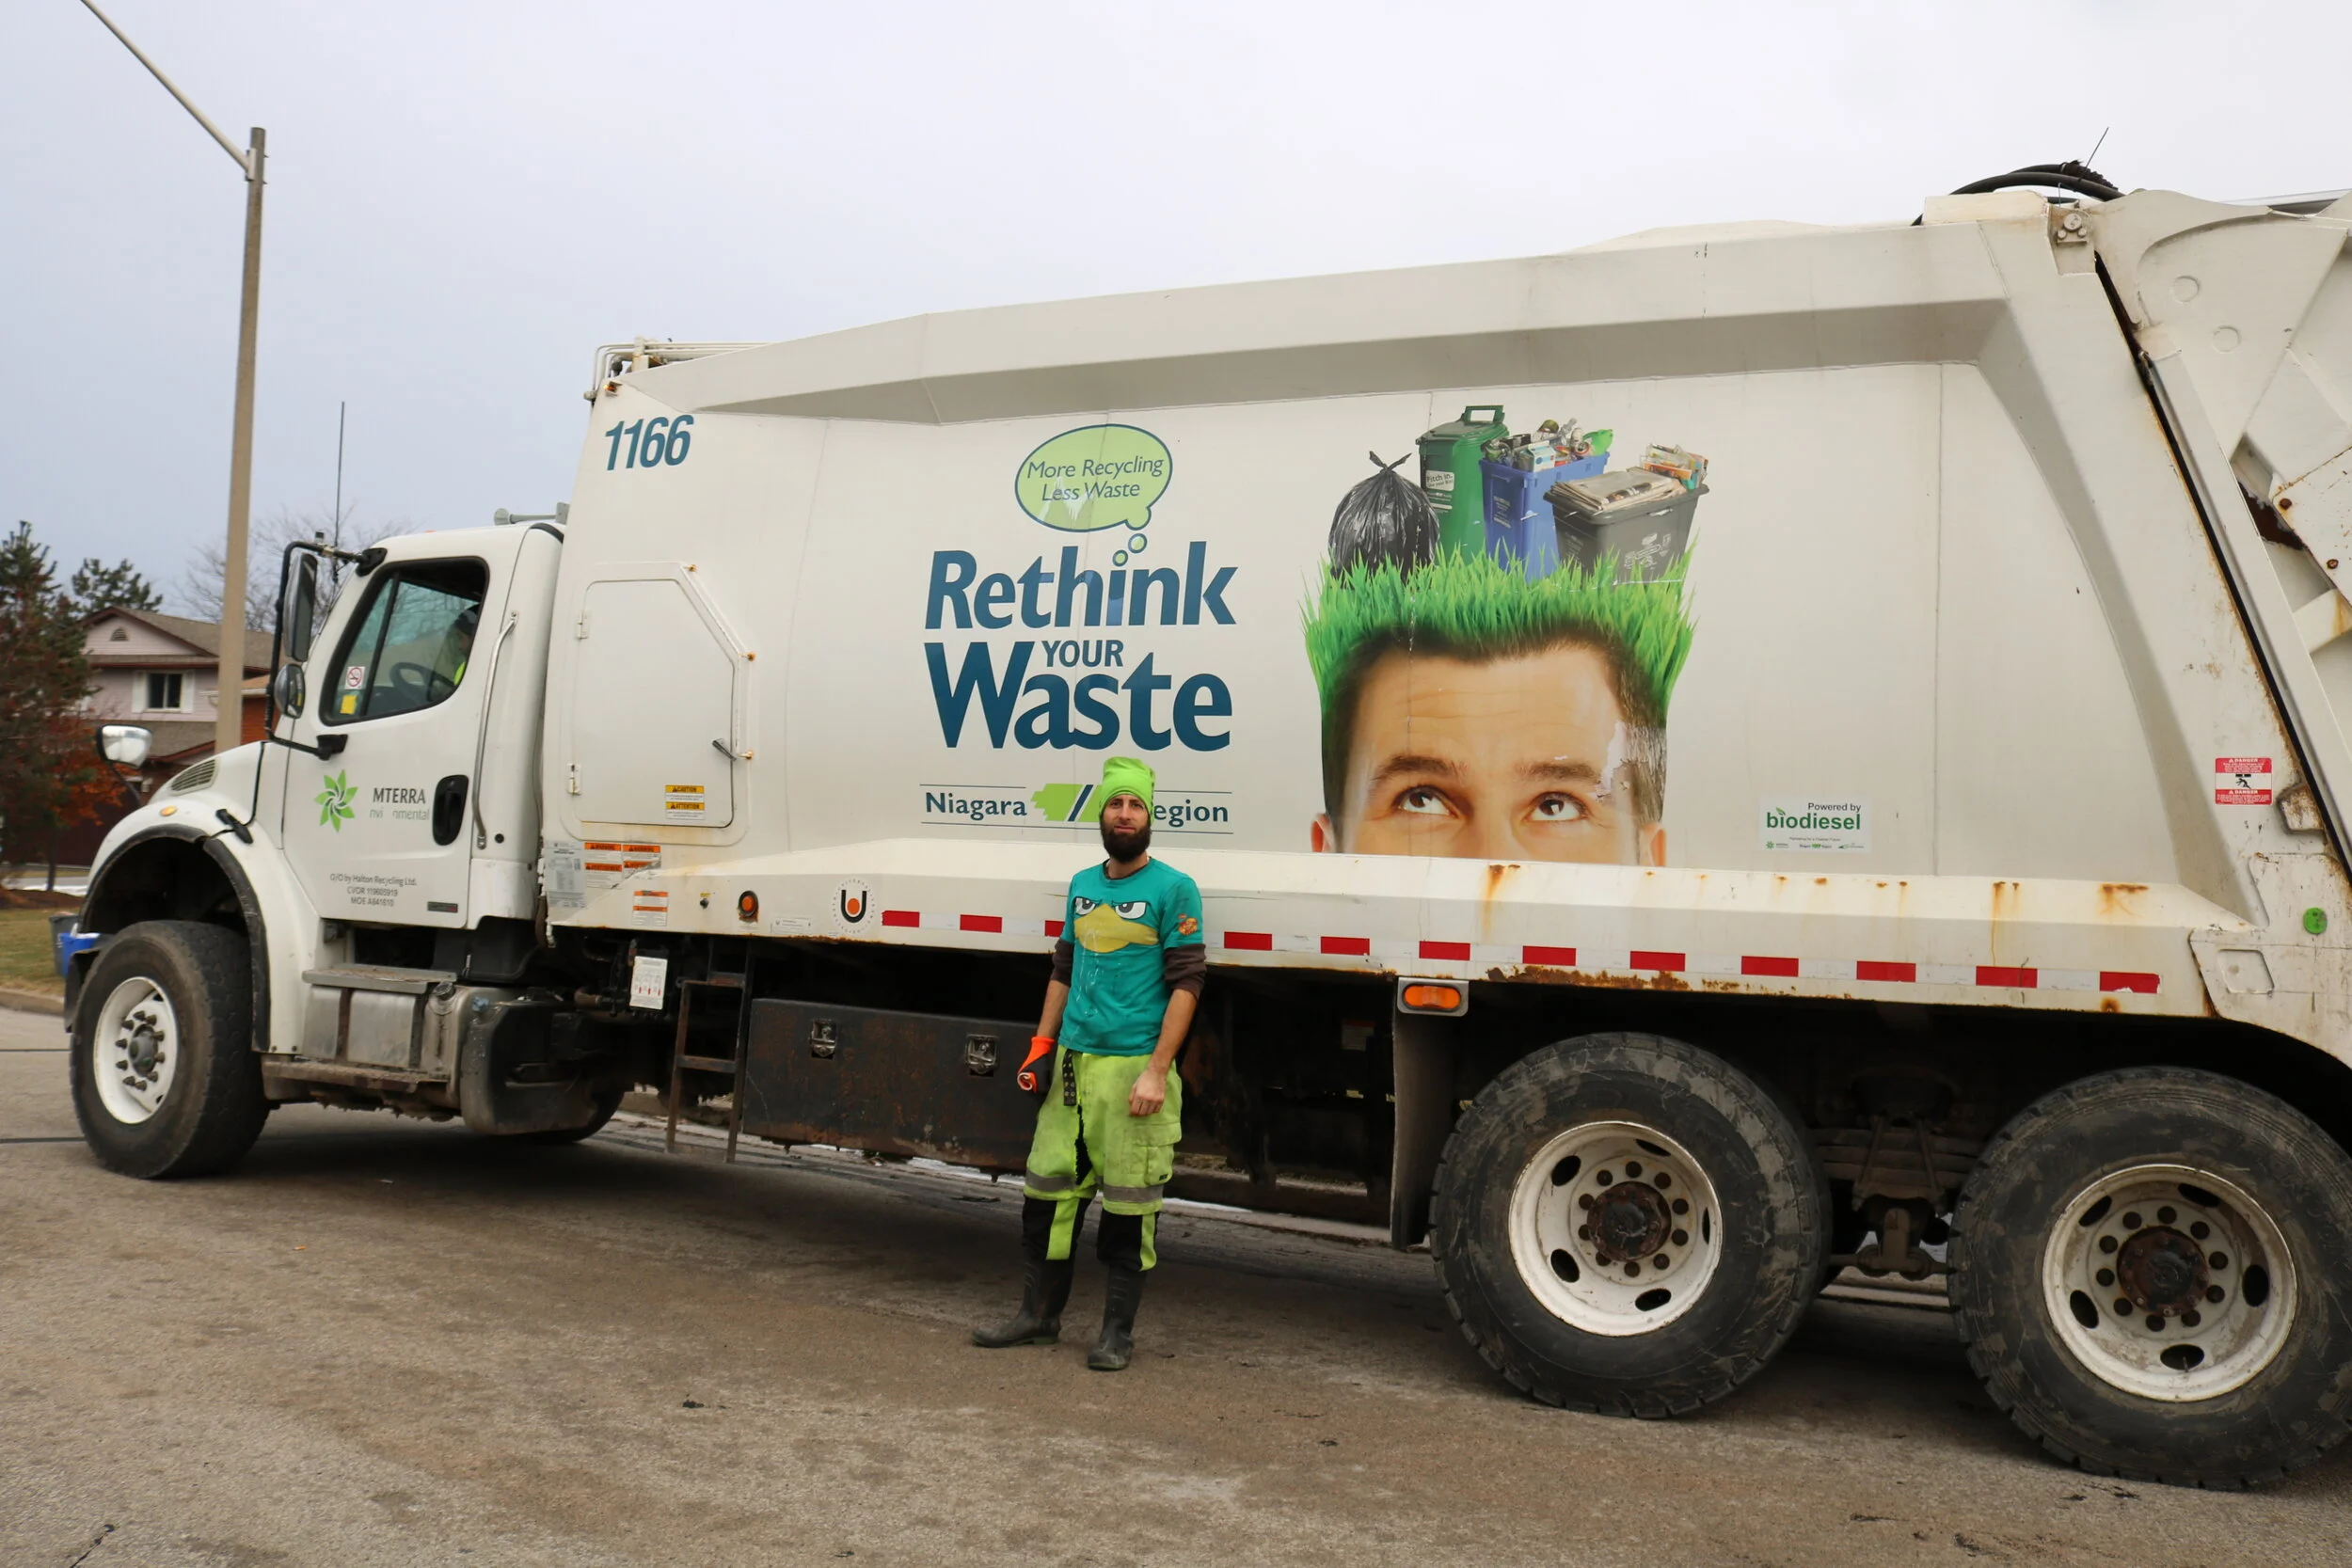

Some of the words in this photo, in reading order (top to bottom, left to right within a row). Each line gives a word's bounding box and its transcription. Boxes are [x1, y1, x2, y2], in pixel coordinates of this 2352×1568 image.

[605, 414, 694, 471] 1166
[1027, 460, 1076, 480] More
[1082, 455, 1164, 480] Recycling
[1041, 483, 1080, 502] Less
[1083, 481, 1140, 500] Waste
[924, 541, 1239, 630] Rethink
[1041, 640, 1123, 668] YOUR
[924, 641, 1233, 752] Waste
[925, 791, 1027, 827] Niagara
[1153, 800, 1230, 829] egion
[1766, 811, 1861, 830] biodiesel
[1850, 804, 1861, 813] by
